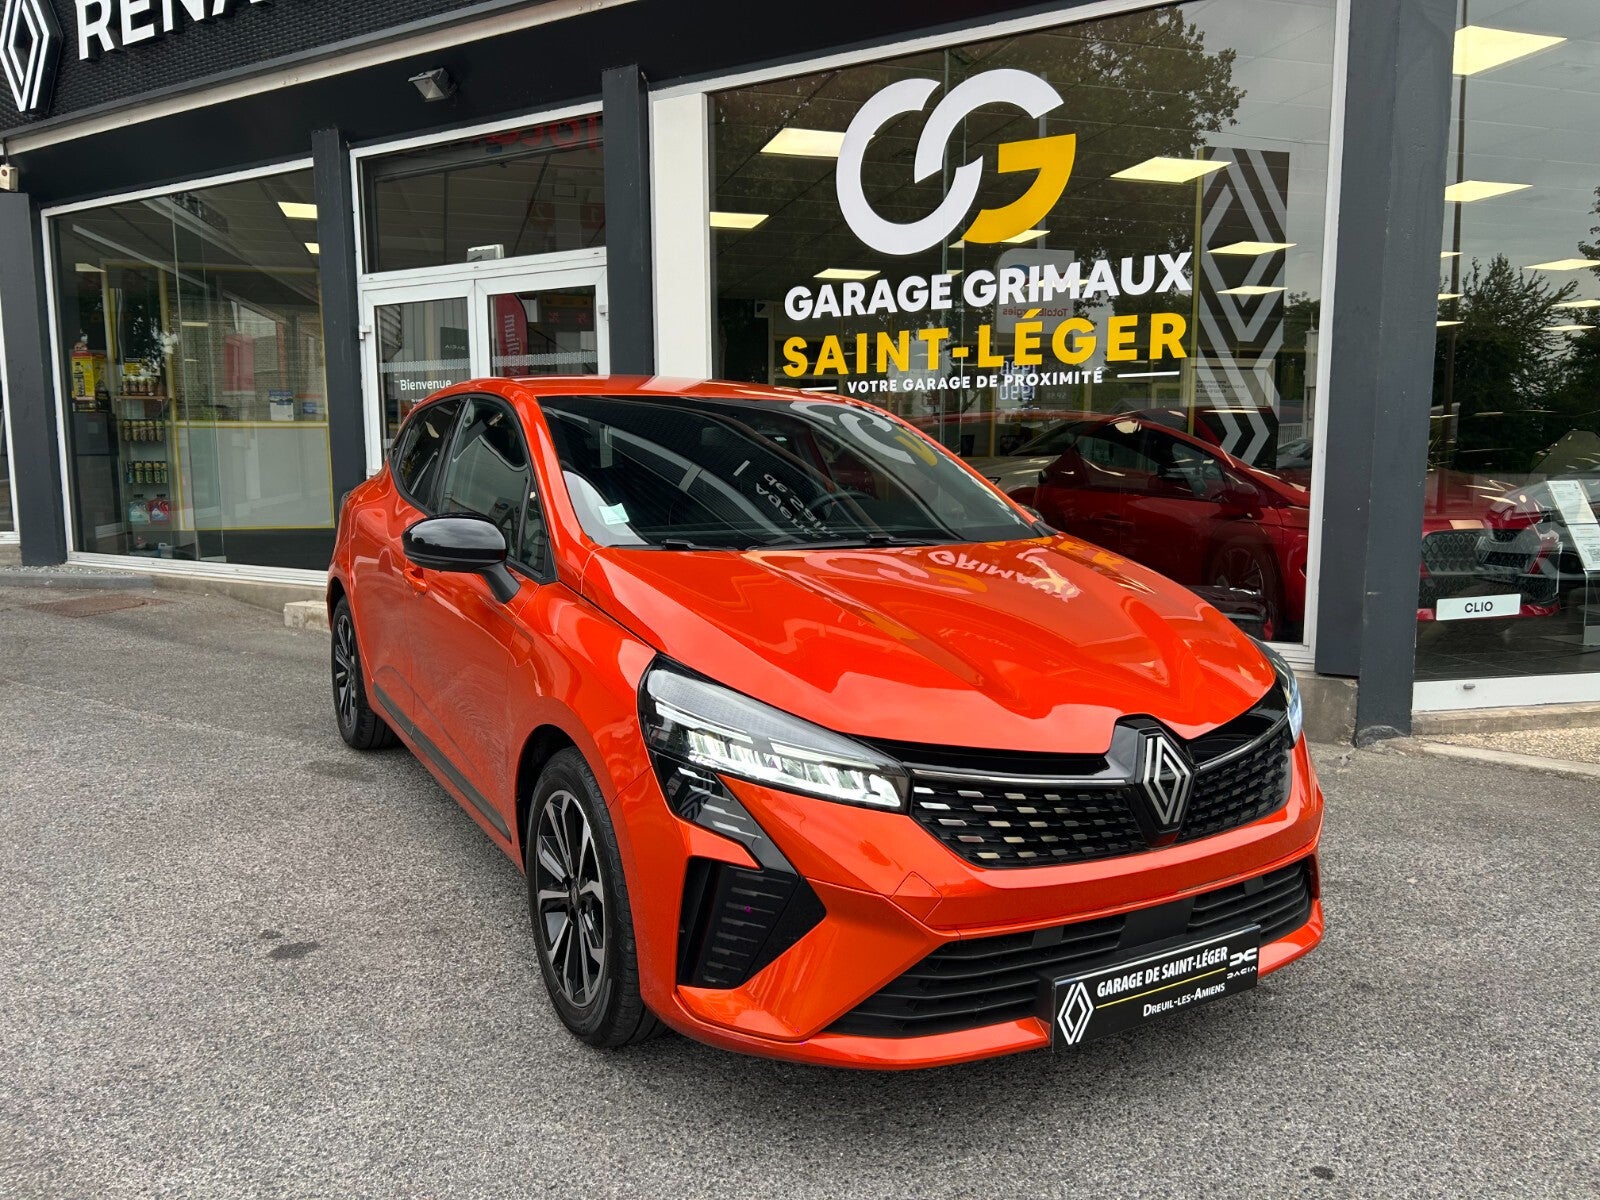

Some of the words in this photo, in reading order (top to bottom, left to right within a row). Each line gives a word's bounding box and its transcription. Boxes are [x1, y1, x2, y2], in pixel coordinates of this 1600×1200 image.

[784, 274, 953, 321] GARAGE
[963, 251, 1193, 308] GRIMAUX
[782, 308, 1188, 378] SAINT-LÉGER
[400, 378, 452, 391] Bienvenue
[847, 379, 898, 394] VOTRE
[902, 376, 971, 391] GARAGE
[976, 374, 998, 388] DE
[1003, 367, 1103, 387] PROXIMITÉ
[1464, 601, 1494, 613] CLIO
[1097, 974, 1143, 998] GARAGE
[1144, 968, 1160, 985] DE
[1161, 946, 1228, 980] SAINT-LÉGER
[1226, 965, 1257, 980] DACIA
